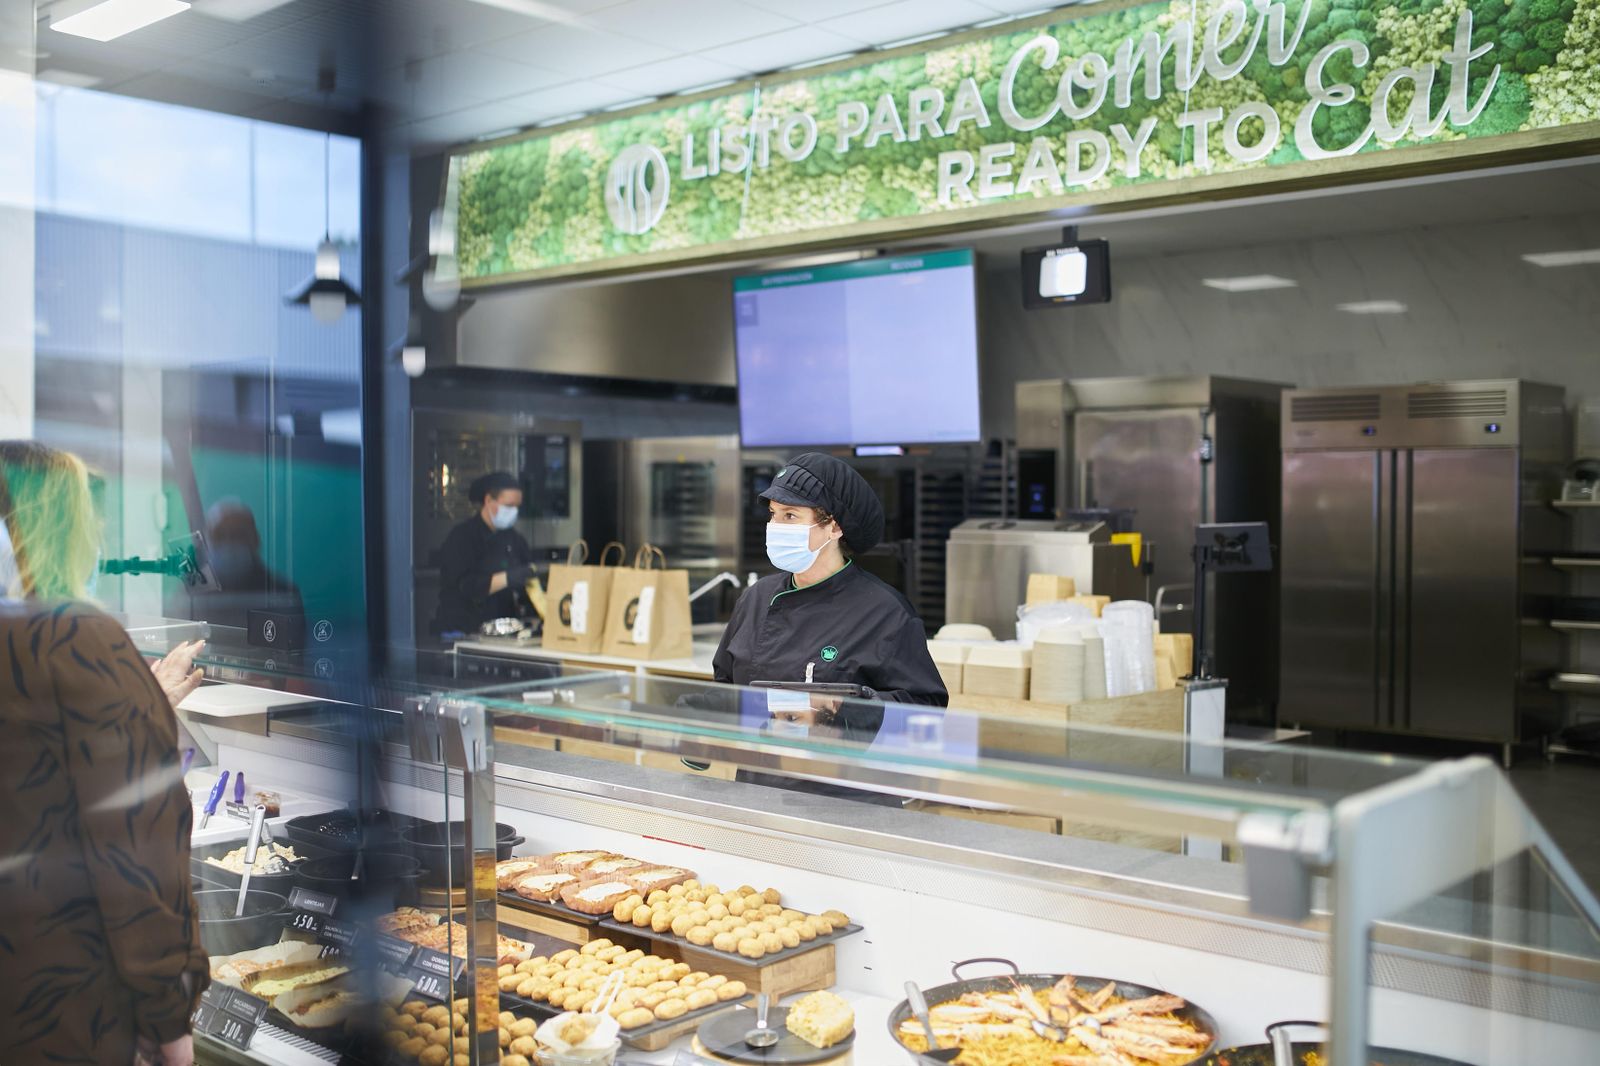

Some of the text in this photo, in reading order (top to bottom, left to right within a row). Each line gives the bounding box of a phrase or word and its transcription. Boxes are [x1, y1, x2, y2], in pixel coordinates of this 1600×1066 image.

[681, 0, 1311, 180] LISTO PARA Comer
[937, 9, 1501, 201] READY TO Eat
